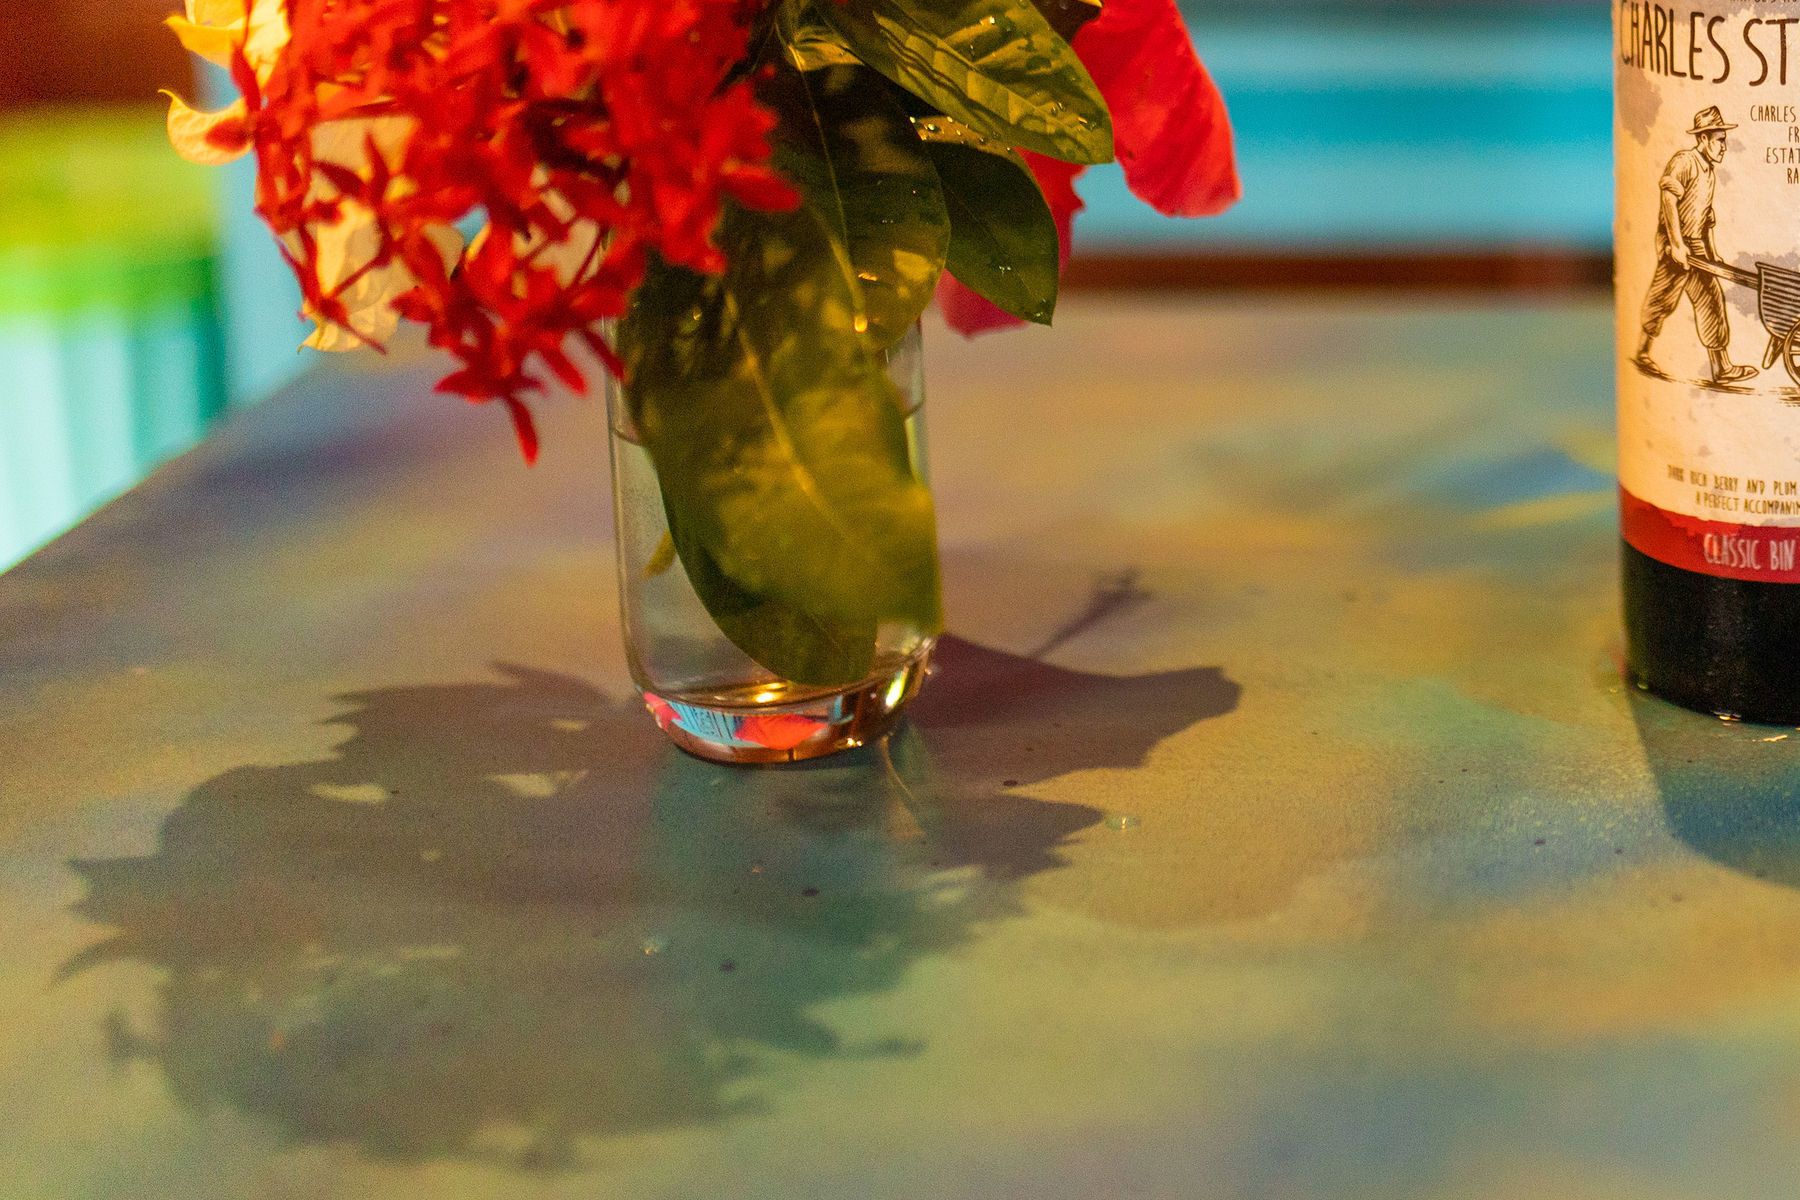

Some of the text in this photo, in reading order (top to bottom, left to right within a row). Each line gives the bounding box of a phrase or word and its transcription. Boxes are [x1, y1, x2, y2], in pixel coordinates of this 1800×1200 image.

[1750, 105, 1796, 123] CHARLES
[1714, 475, 1739, 493] BERRY
[1746, 479, 1766, 496] AND
[1773, 480, 1798, 497] PLUM
[1703, 491, 1740, 512] PERFECT
[1703, 533, 1761, 571] CLASSIC
[1769, 539, 1796, 571] BIN
